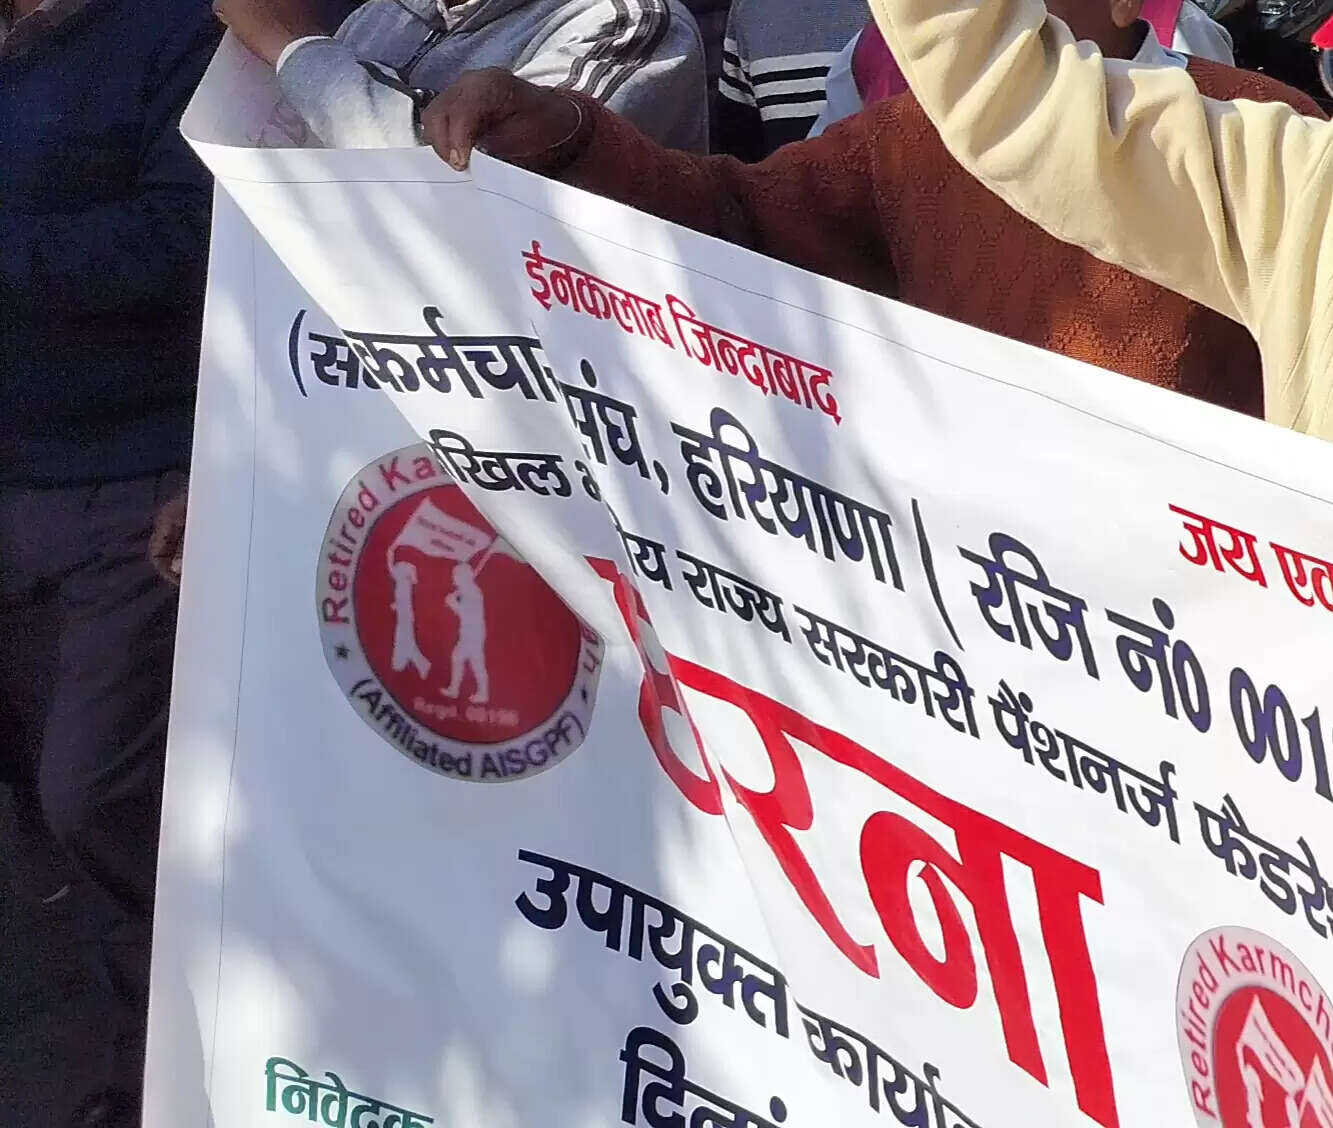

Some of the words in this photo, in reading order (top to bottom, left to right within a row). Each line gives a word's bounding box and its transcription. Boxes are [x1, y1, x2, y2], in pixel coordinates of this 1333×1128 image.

[521, 240, 675, 350] ईनकलाब
[664, 293, 842, 426] जिन्दाबाद
[321, 480, 379, 625] Retired
[429, 428, 572, 498] खिल
[675, 549, 793, 644] राज्य
[792, 602, 981, 741] सरकारी
[669, 406, 906, 593] हरियाणा
[956, 532, 1100, 680] रजि
[1168, 503, 1268, 588] जय
[350, 678, 473, 776] (Affiliated
[513, 848, 793, 1040] उपायुक्त
[1182, 951, 1219, 1121] Retired
